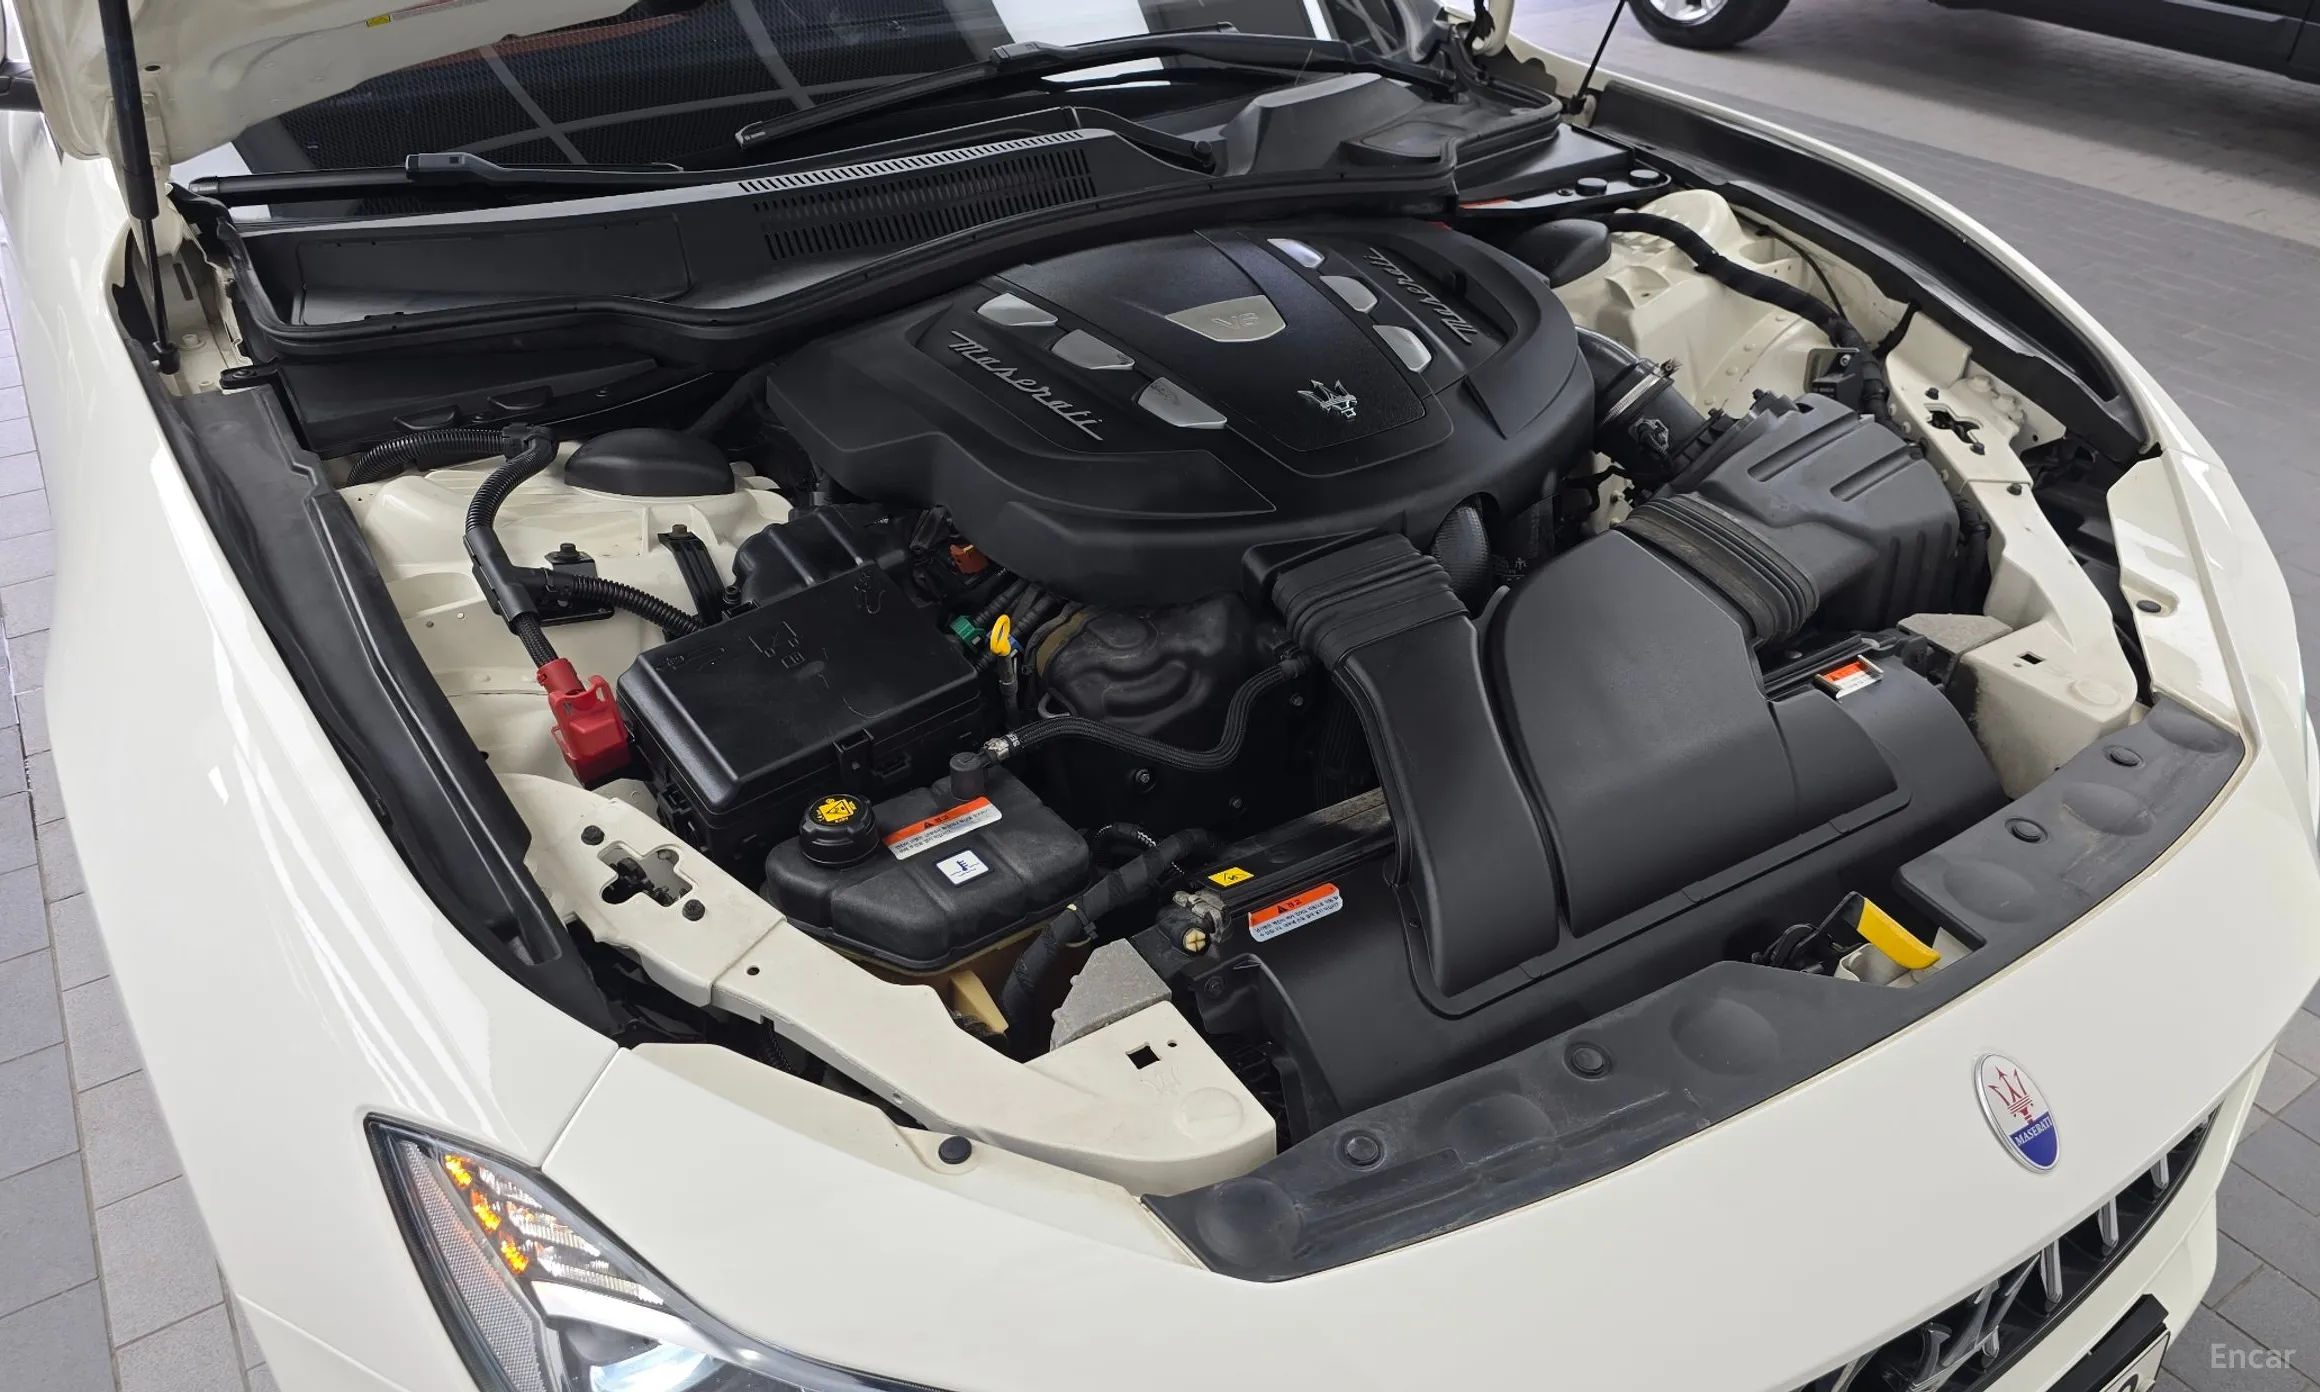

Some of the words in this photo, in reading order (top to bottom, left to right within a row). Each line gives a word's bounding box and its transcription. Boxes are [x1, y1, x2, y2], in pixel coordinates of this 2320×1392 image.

[1209, 312, 1259, 330] V6
[1363, 247, 1478, 345] Maserati
[948, 330, 1103, 441] Maserati
[2014, 1116, 2053, 1147] MASERATI
